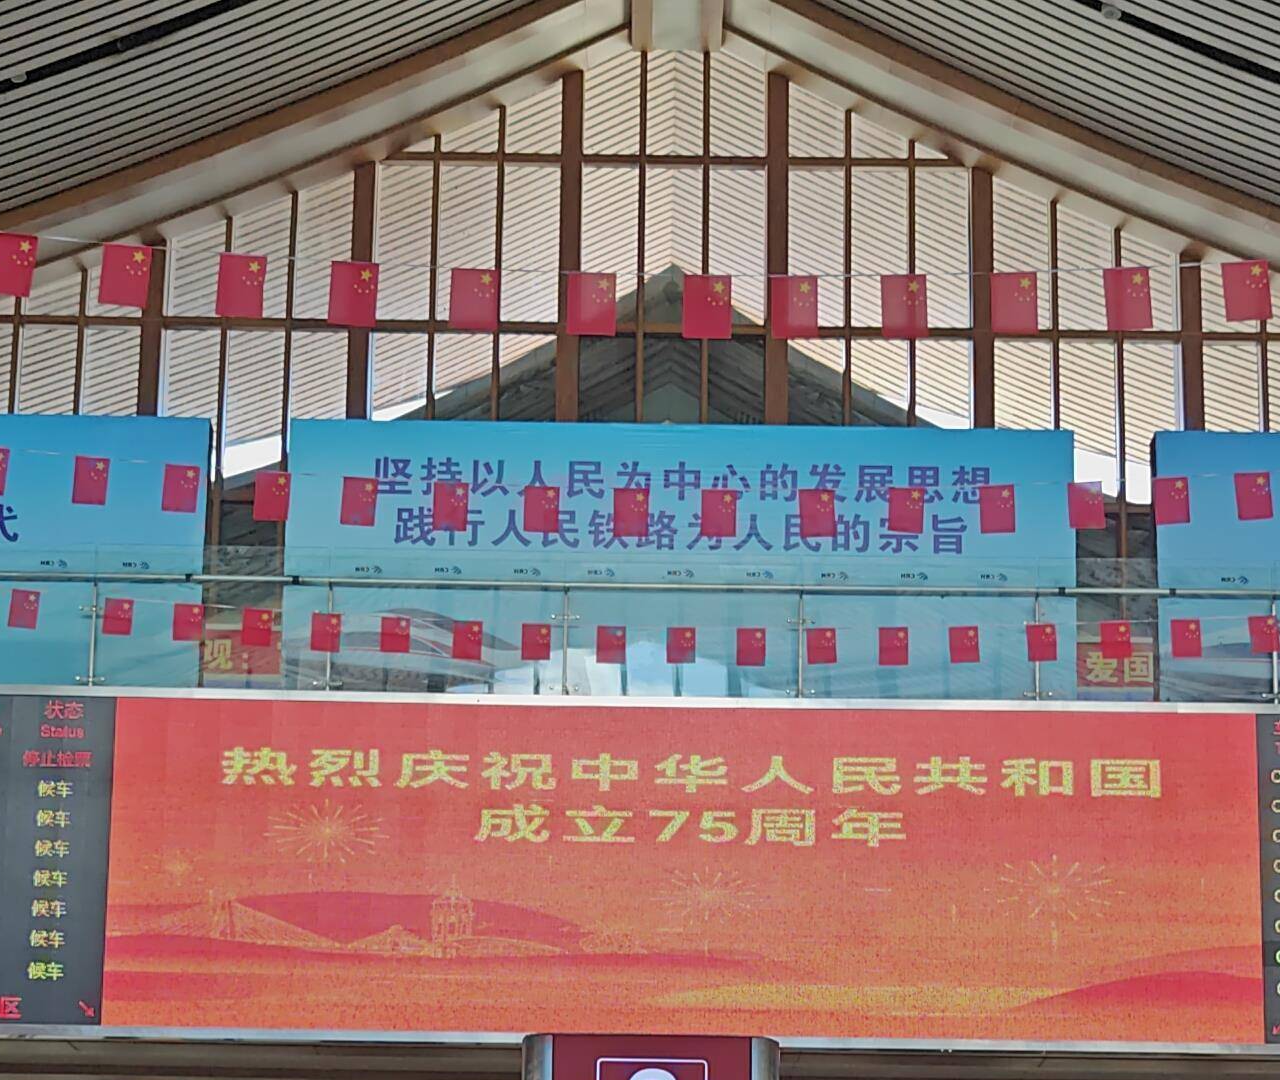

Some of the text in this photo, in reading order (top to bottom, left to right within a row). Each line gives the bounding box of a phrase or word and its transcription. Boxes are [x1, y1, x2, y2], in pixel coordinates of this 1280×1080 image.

[45, 701, 84, 720] 状态
[40, 725, 85, 739] Status
[222, 746, 1165, 799] 热烈庆祝中华人民共和国
[473, 806, 907, 849] 成立75周年
